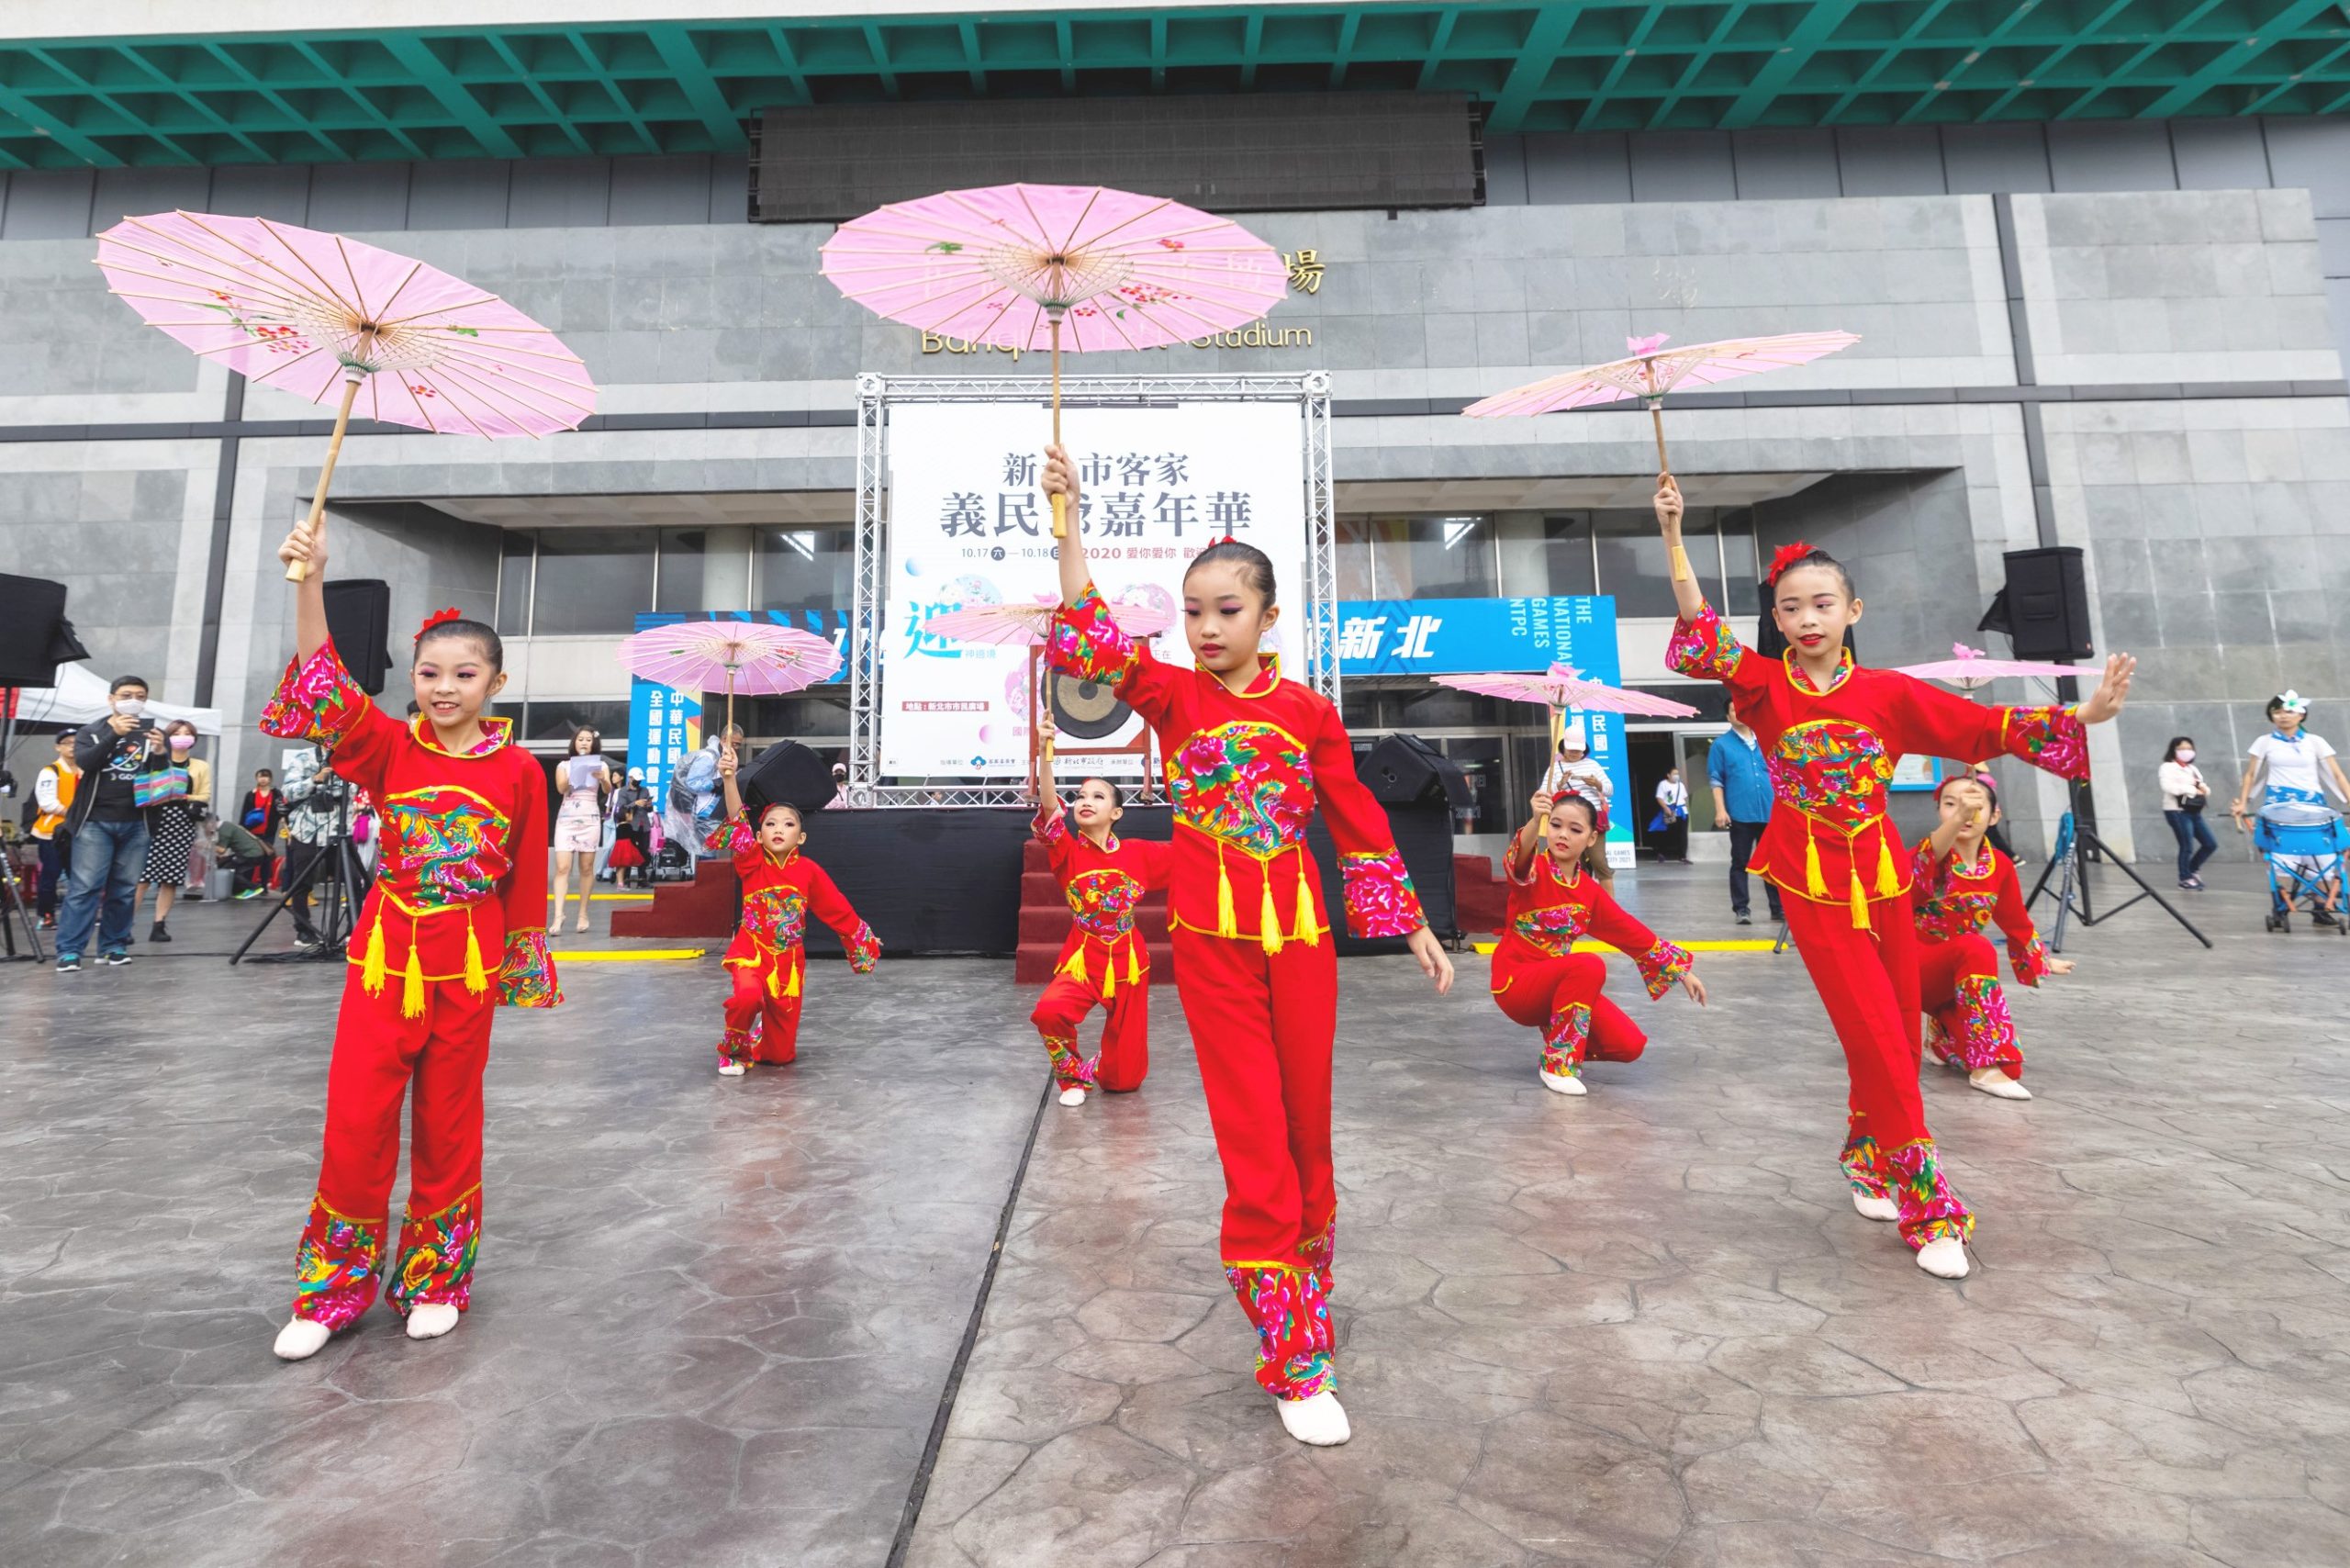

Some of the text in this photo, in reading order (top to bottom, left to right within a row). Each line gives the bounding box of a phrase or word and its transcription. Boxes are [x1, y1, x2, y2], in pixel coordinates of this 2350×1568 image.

[1002, 452, 1190, 487] 新市客家
[1081, 547, 1122, 559] 2020
[1509, 599, 1528, 636] NTPC
[1531, 598, 1550, 648] GAMES
[1575, 597, 1592, 624] THE
